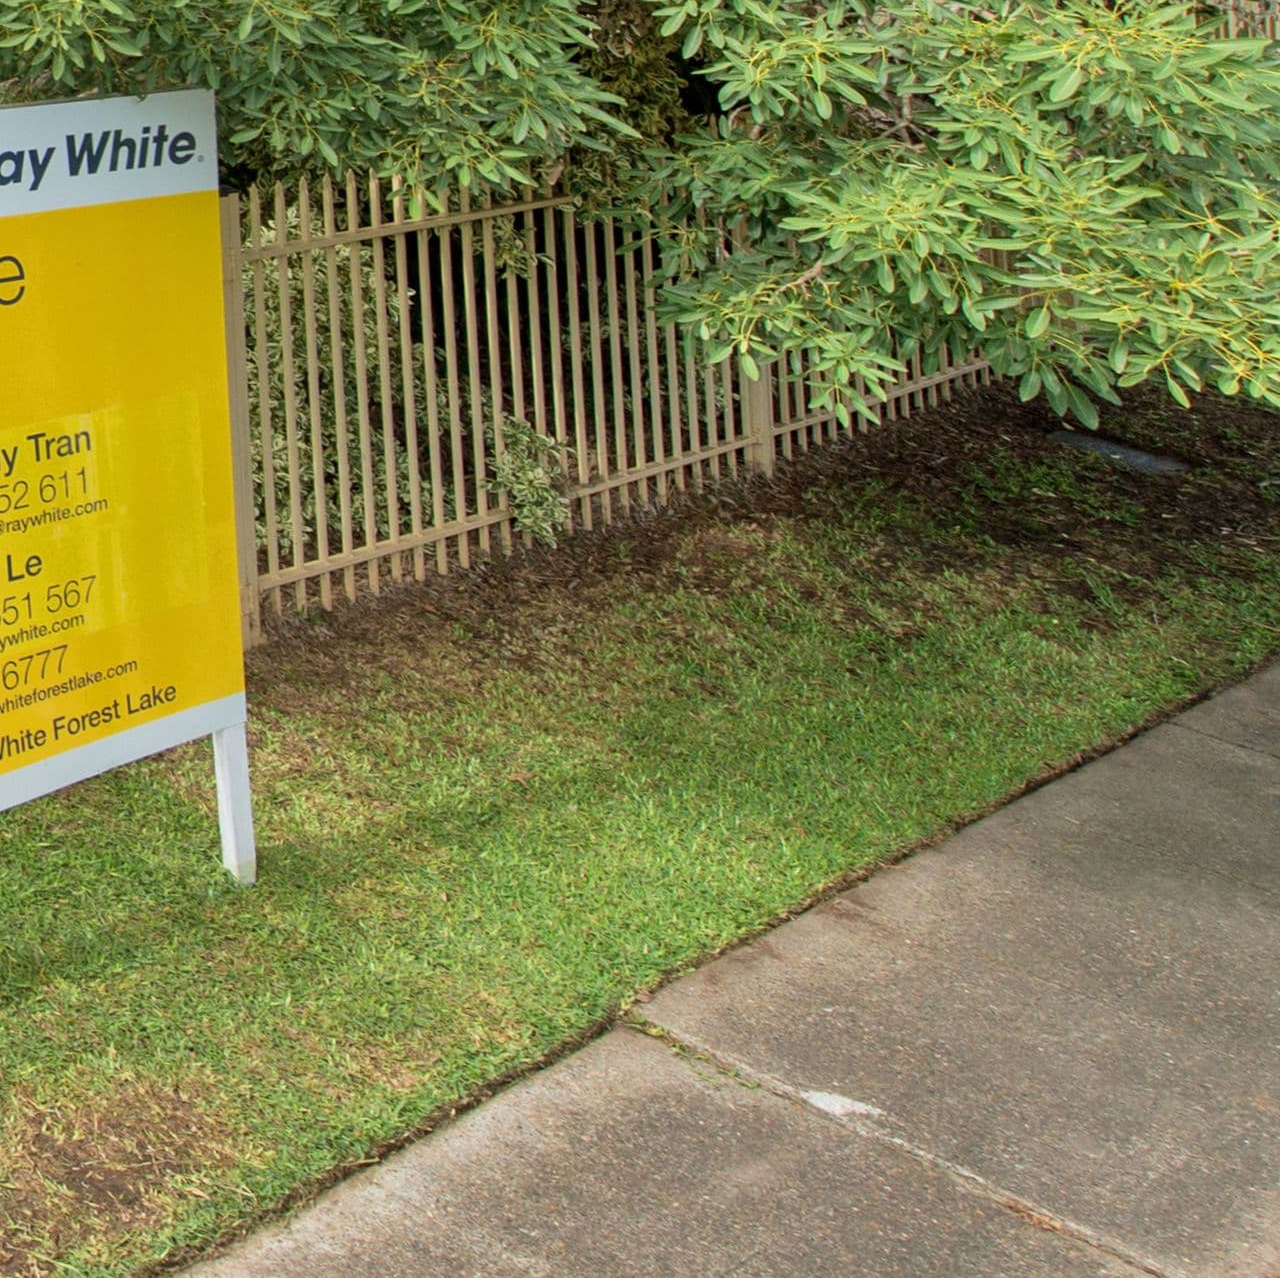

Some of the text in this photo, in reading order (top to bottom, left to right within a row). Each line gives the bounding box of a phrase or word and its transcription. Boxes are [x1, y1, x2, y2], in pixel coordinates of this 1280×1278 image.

[66, 124, 197, 177] White
[26, 430, 92, 463] Tran
[39, 466, 88, 504] 611
[6, 554, 43, 583] Le
[46, 574, 97, 614] 567
[2, 644, 69, 691] 6777
[53, 698, 122, 742] Forest
[127, 683, 178, 717] Lake
